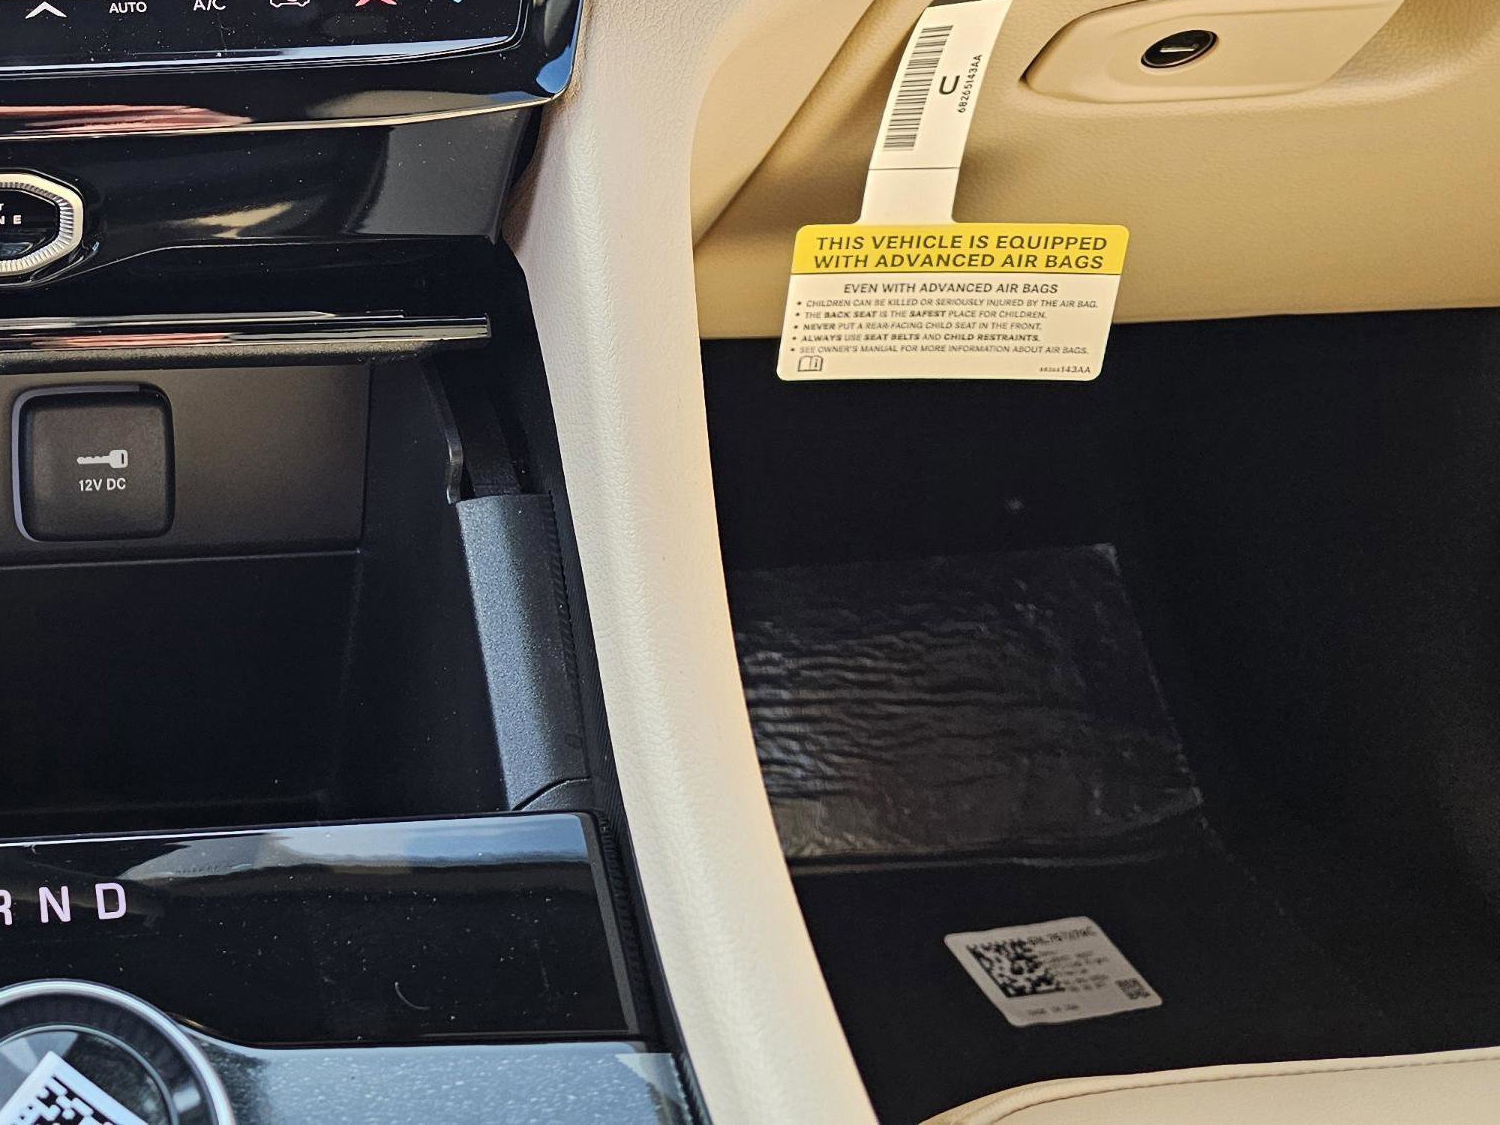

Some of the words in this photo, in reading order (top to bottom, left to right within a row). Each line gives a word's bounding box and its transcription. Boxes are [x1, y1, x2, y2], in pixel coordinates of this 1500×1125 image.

[109, 1, 147, 13] AUTO
[816, 236, 865, 250] THIS
[872, 235, 962, 249] VEHICLE
[969, 235, 989, 249] IS
[996, 235, 1107, 250] EQUIPPED
[814, 254, 868, 268] WITH
[875, 254, 995, 267] ADVANCED
[1001, 254, 1038, 268] AIR
[1045, 255, 1104, 269] BAGS
[843, 283, 878, 293] EVEN
[881, 283, 916, 293] WITH
[919, 283, 992, 293] ADVANCED
[996, 283, 1019, 293] AIR
[1022, 283, 1058, 294] BAGS
[806, 299, 851, 307] CHILDREN
[888, 298, 918, 306] KILLED
[920, 298, 933, 306] OR
[935, 298, 984, 306] SERIOUSLY
[987, 299, 1024, 307] INJURED
[1026, 299, 1039, 307] BY
[948, 310, 976, 318] PLACE
[801, 334, 842, 342] ALWAYS
[943, 333, 975, 341] CHILD
[1045, 346, 1060, 354] AIR
[78, 479, 102, 491] 12V
[106, 479, 126, 490] DC
[38, 885, 71, 923] N
[94, 882, 127, 920] D
